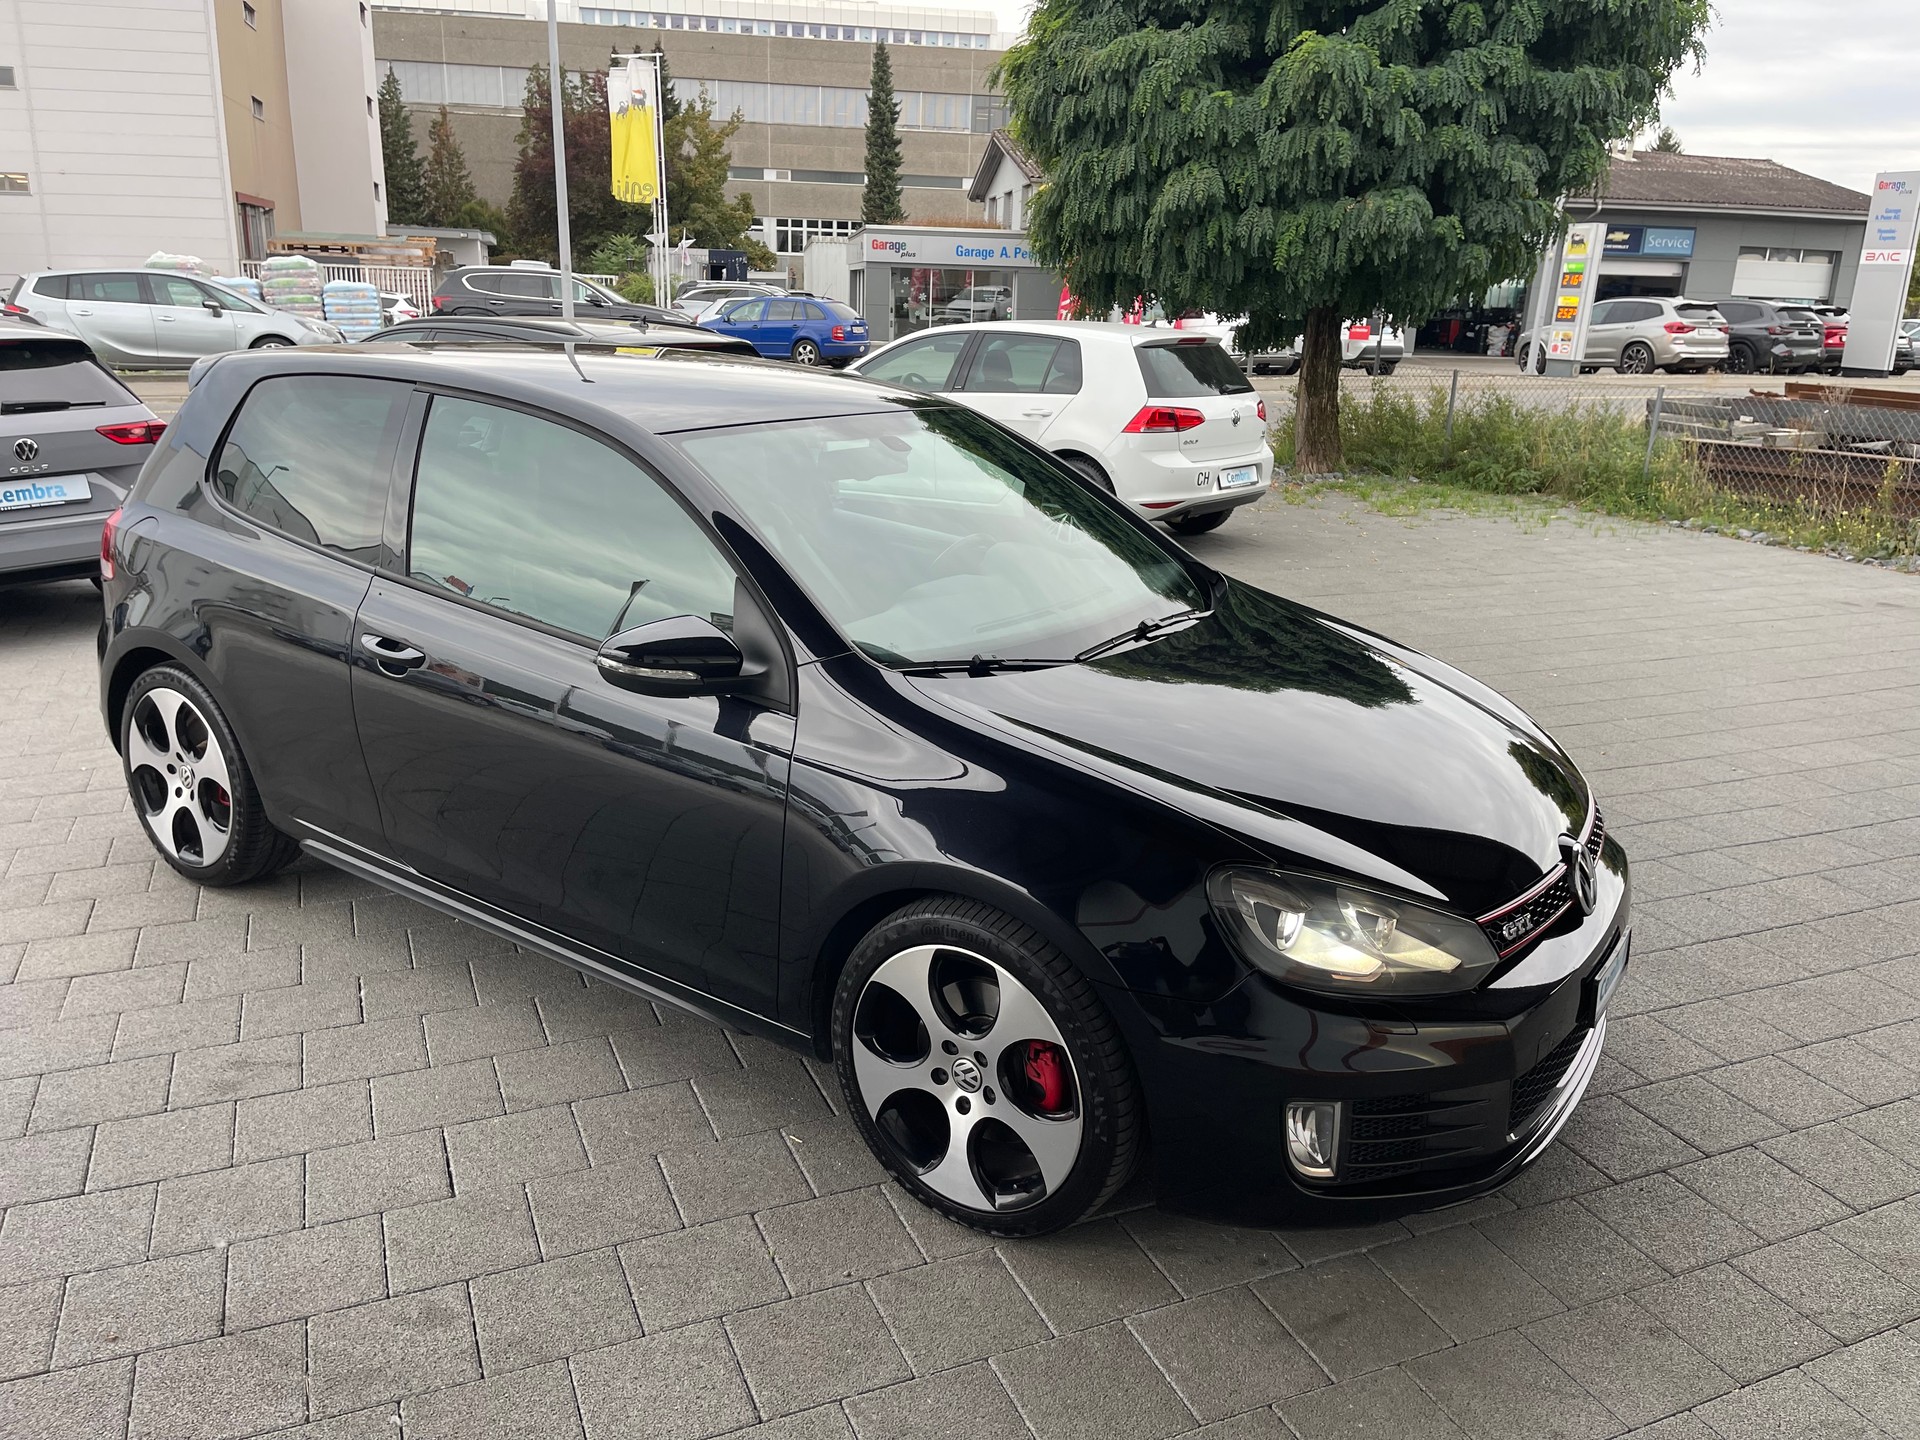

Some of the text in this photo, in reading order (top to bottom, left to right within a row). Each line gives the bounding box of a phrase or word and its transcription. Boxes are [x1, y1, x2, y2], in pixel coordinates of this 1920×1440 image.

[1879, 181, 1906, 191] Garage
[871, 239, 907, 253] Garage
[1648, 235, 1690, 248] Service
[900, 250, 917, 258] plus
[955, 244, 995, 260] Garage
[1000, 246, 1011, 259] A.
[1865, 252, 1901, 262] BAIC
[9, 463, 49, 474] GOLF
[1196, 471, 1211, 487] CH
[0, 483, 67, 503] embra
[1502, 912, 1534, 940] GTI
[921, 922, 993, 950] Continental
